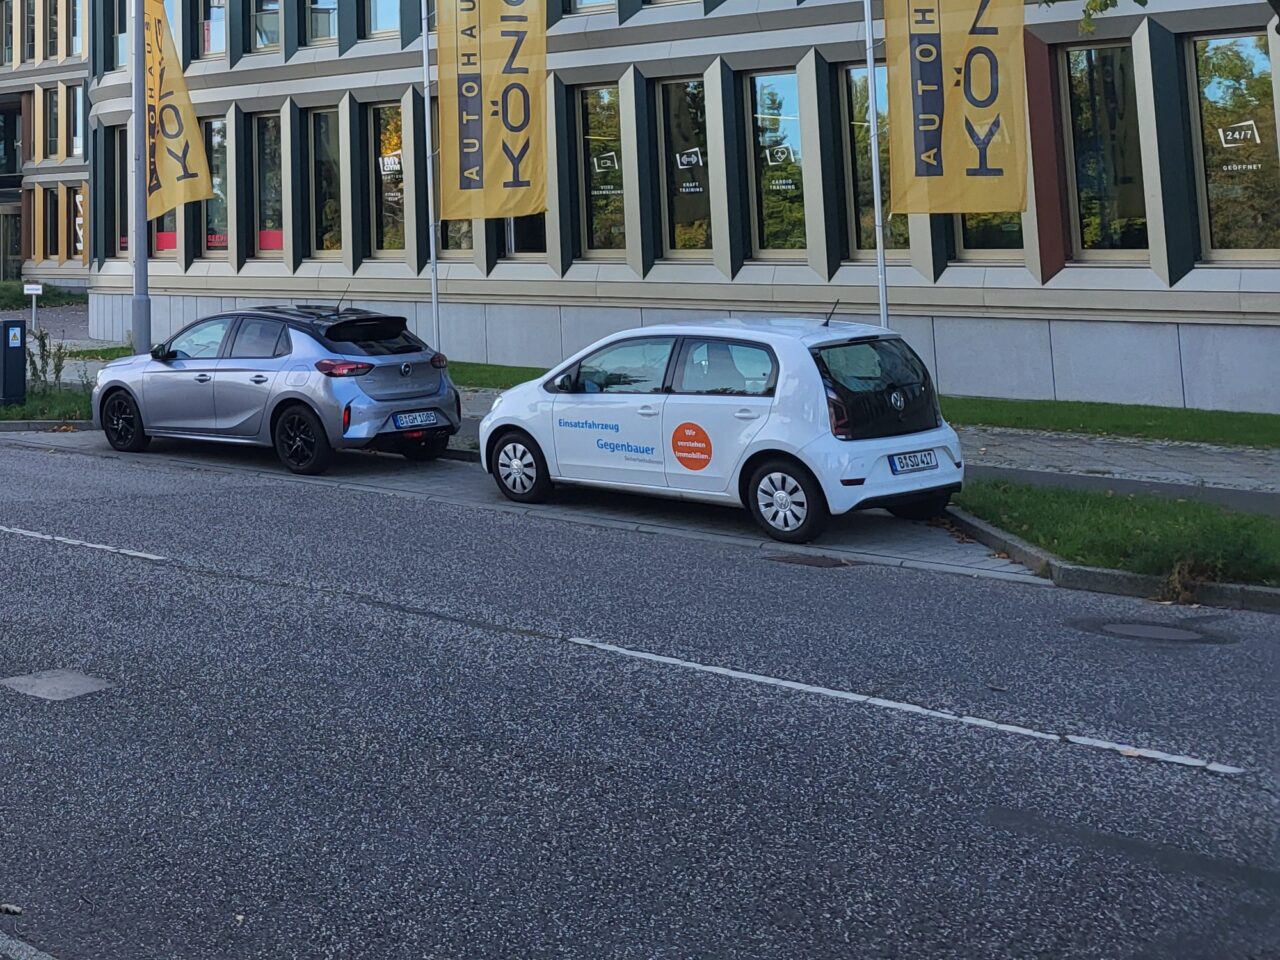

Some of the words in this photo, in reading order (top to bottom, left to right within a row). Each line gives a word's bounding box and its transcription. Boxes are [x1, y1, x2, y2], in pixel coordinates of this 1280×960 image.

[1226, 130, 1252, 140] 24/7
[384, 157, 399, 165] MY
[1223, 163, 1262, 171] GEÖFFNET
[558, 418, 619, 433] Einsatzfahrzeug
[596, 438, 656, 455] Gegenbauer
